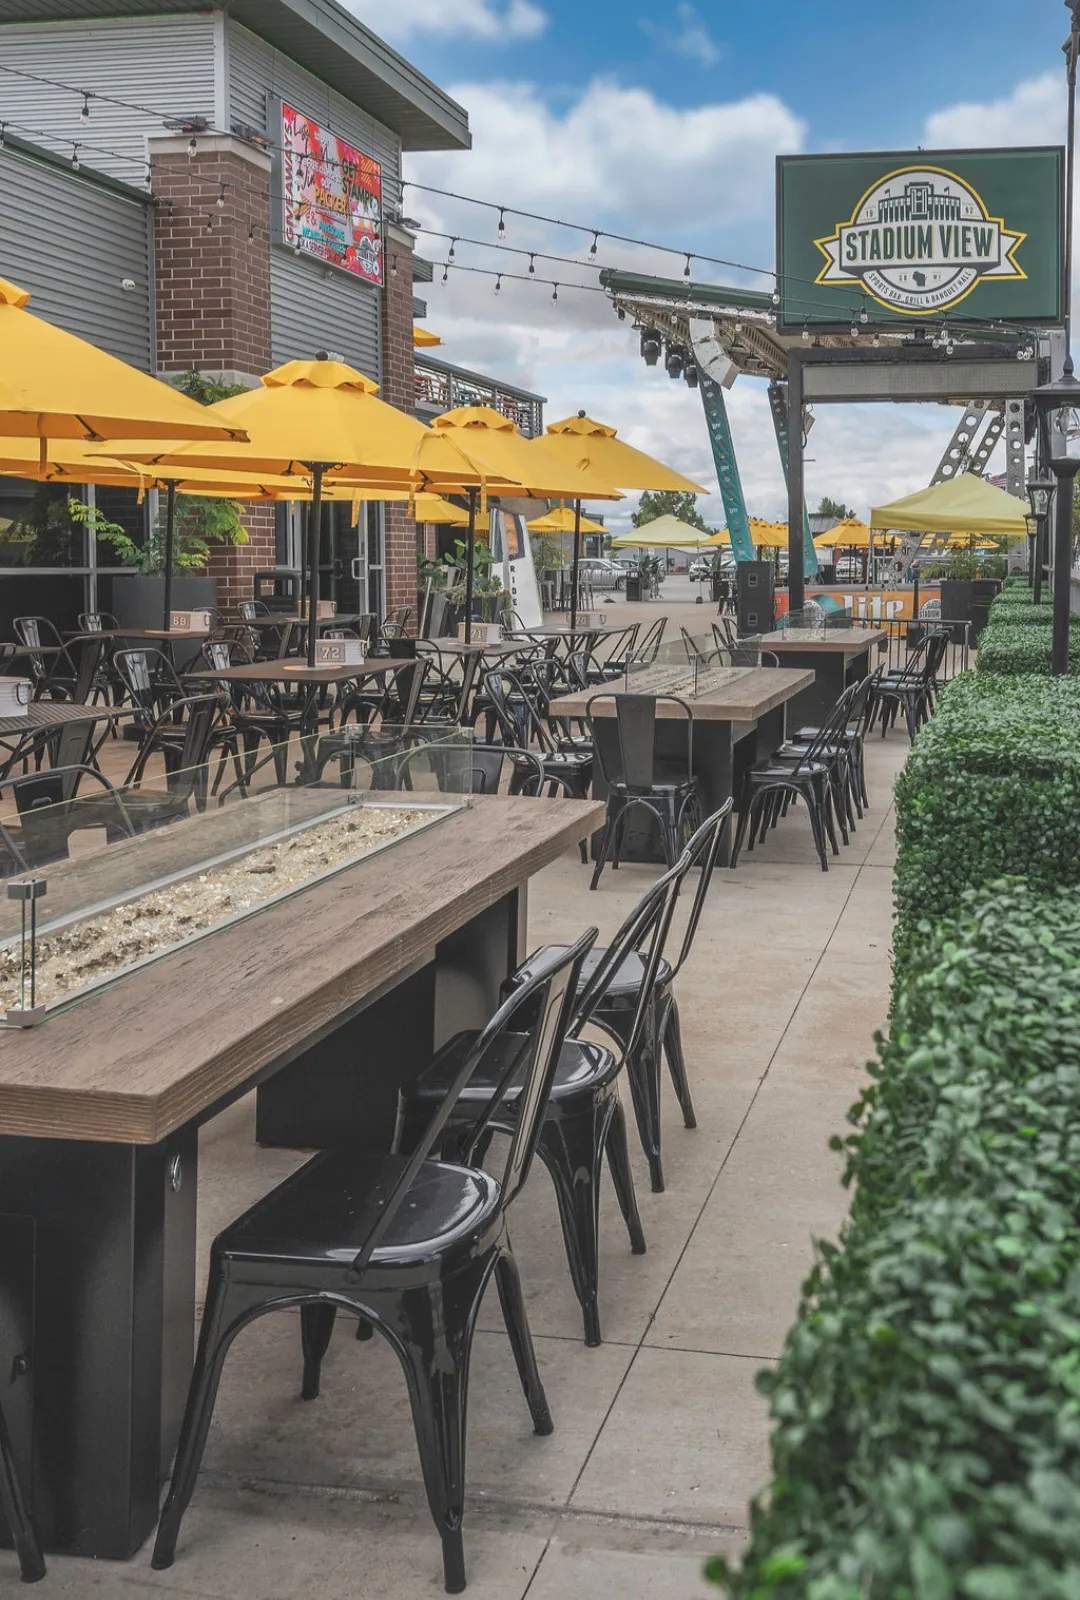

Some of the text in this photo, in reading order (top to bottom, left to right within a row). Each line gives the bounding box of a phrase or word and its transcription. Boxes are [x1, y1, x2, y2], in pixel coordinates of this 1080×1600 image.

[846, 225, 994, 261] STADIUM VIEW
[868, 273, 888, 295] SPORTS
[904, 295, 923, 305] GRILL
[931, 284, 959, 303] BANQUET
[959, 270, 972, 287] HALL
[321, 647, 340, 659] 72
